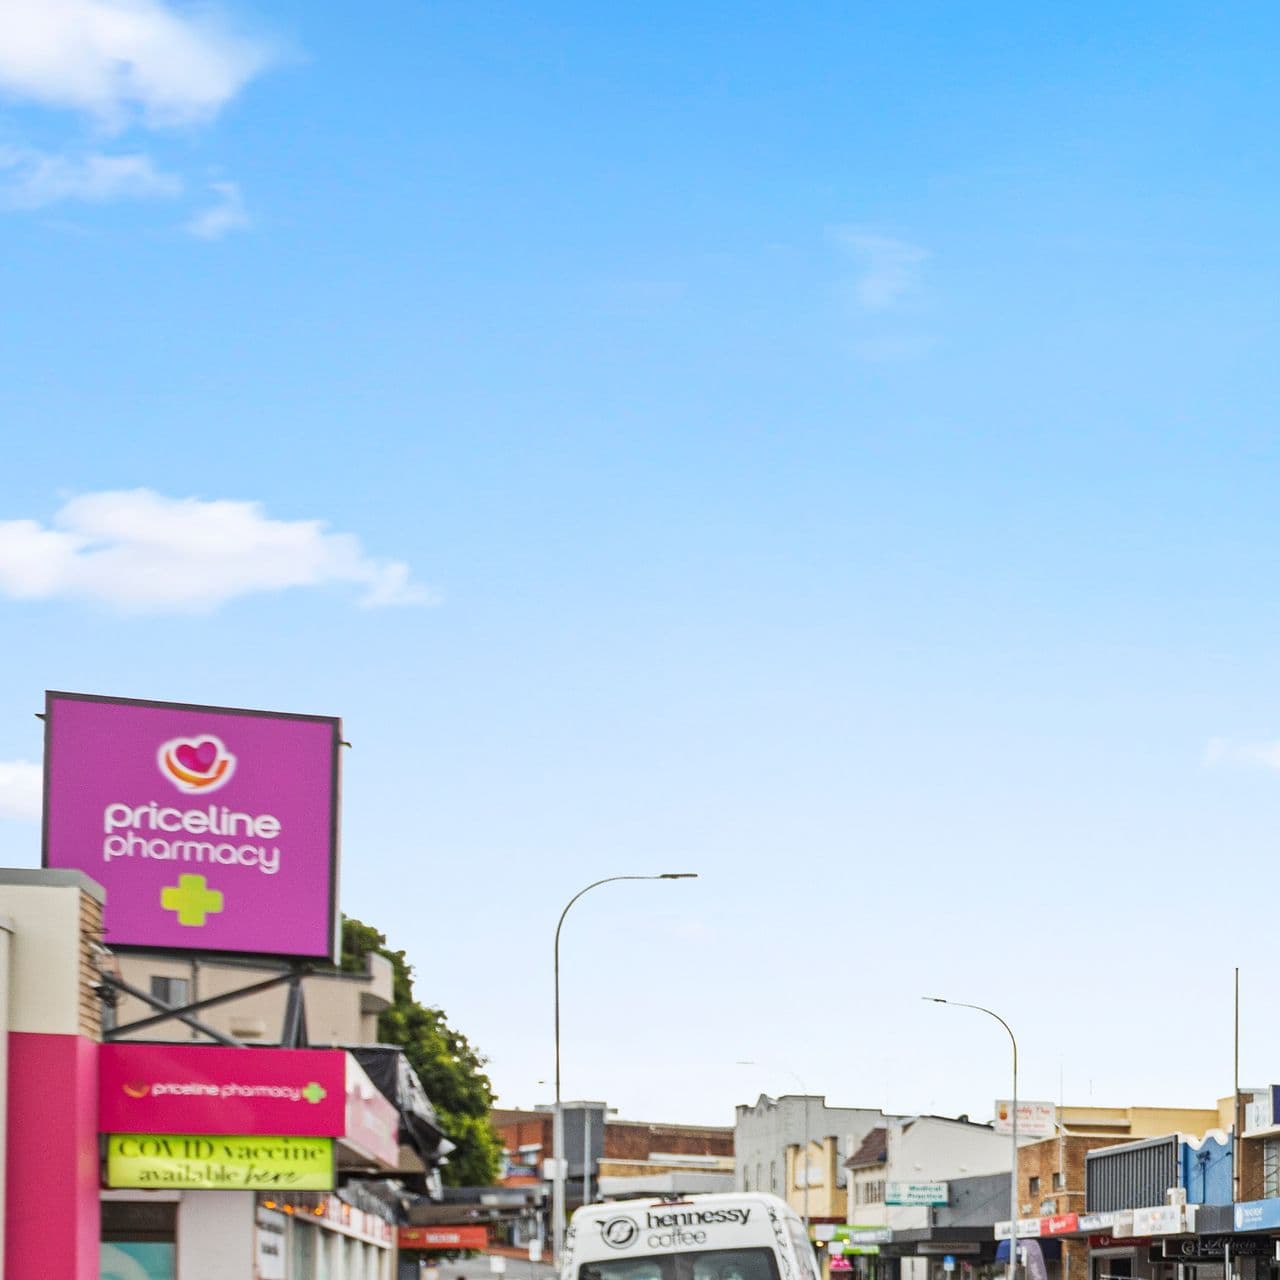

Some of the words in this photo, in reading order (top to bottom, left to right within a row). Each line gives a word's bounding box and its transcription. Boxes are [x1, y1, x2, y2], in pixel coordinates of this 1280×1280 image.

[103, 801, 282, 839] priceline
[103, 831, 280, 875] pharmacy
[151, 1082, 219, 1097] priceline
[220, 1084, 300, 1101] pharmacy
[118, 1138, 215, 1160] COVID
[222, 1138, 326, 1161] vaccine
[138, 1164, 241, 1185] available
[647, 1208, 751, 1230] hennessy
[648, 1229, 707, 1249] coffee
